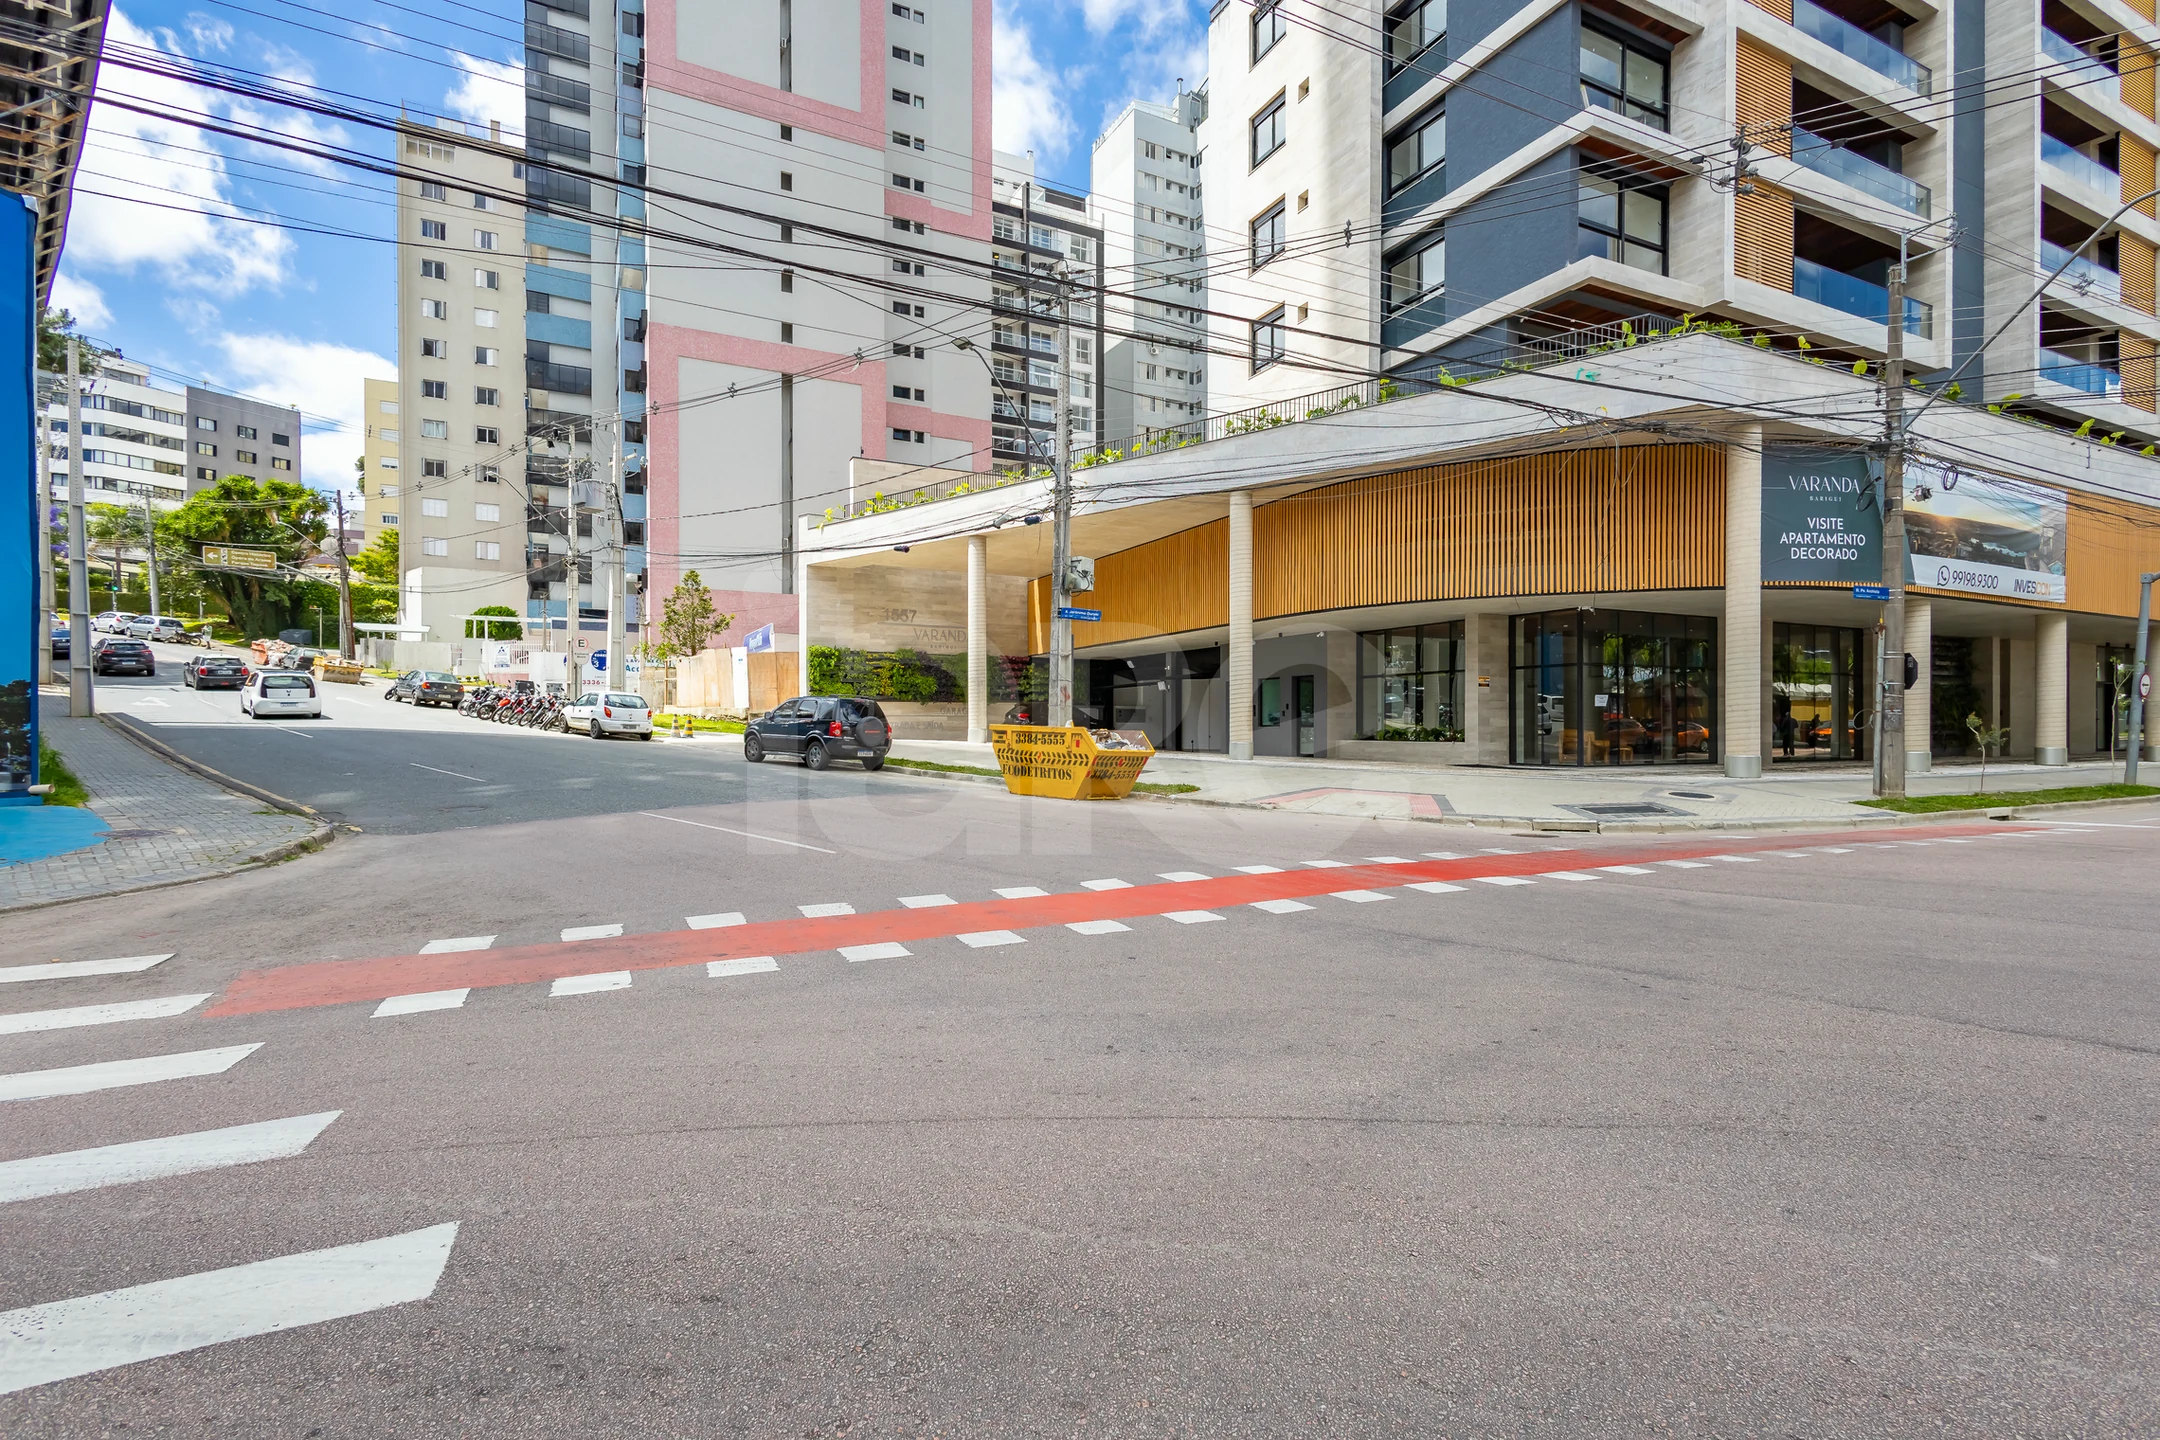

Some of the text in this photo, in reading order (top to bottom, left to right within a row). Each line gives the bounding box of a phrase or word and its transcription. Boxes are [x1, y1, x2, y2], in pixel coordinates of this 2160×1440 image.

[1789, 475, 1860, 494] VARANDA
[1807, 517, 1844, 530] VISITE
[1780, 532, 1866, 547] APARTAMENTO
[1791, 547, 1858, 561] DECORADO
[1952, 570, 1999, 589] 99198.9300
[884, 607, 918, 623] 1557
[913, 627, 969, 642] VARAND
[578, 639, 585, 647] E
[940, 706, 968, 715] GARAG
[1015, 732, 1066, 746] 3384-5555
[1002, 763, 1072, 781] ECODETRITOS
[1090, 769, 1137, 780] 3384-5555
